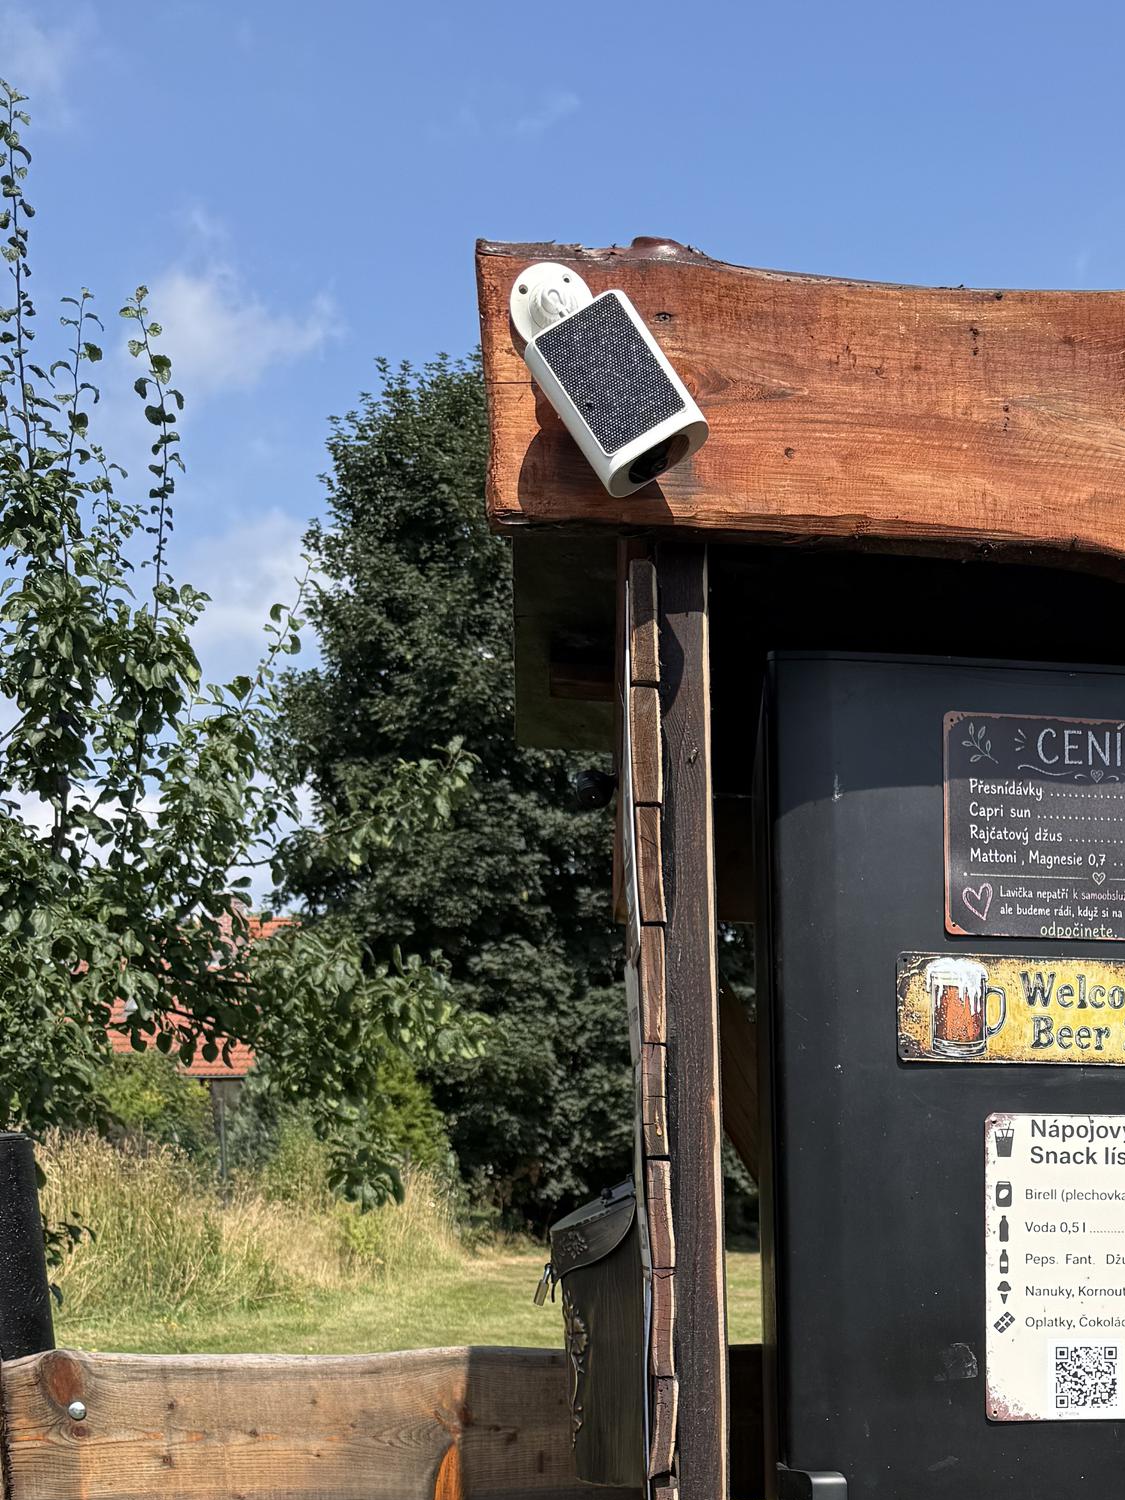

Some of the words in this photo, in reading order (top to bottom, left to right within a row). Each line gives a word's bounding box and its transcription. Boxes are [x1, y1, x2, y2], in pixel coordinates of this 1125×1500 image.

[969, 778, 1043, 801] Přesnídávky
[969, 801, 1004, 821] Capri
[1010, 807, 1031, 818] sun
[969, 824, 1029, 845] Rajčatový
[1034, 827, 1063, 842] džus
[970, 848, 1017, 863] Mattoni
[1029, 850, 1083, 870] Magnesie
[1088, 853, 1107, 868] 0,7
[1000, 885, 1033, 900] Lavička
[1036, 888, 1069, 902] nepatří
[1073, 888, 1078, 900] k
[1000, 903, 1013, 915] ale
[1016, 904, 1051, 916] budeme
[1054, 905, 1075, 918] rádi,
[1077, 906, 1099, 921] když
[1101, 907, 1109, 918] si
[1112, 910, 1123, 919] na
[1040, 921, 1118, 938] odpočinete.
[1030, 1016, 1111, 1050] Beer
[1030, 1145, 1098, 1165] Snack
[1025, 1188, 1057, 1200] Birell
[1025, 1221, 1056, 1233] Voda
[1059, 1221, 1080, 1234] 0,5
[1025, 1285, 1075, 1299] Nanuky,
[1025, 1316, 1076, 1329] Oplatky,
